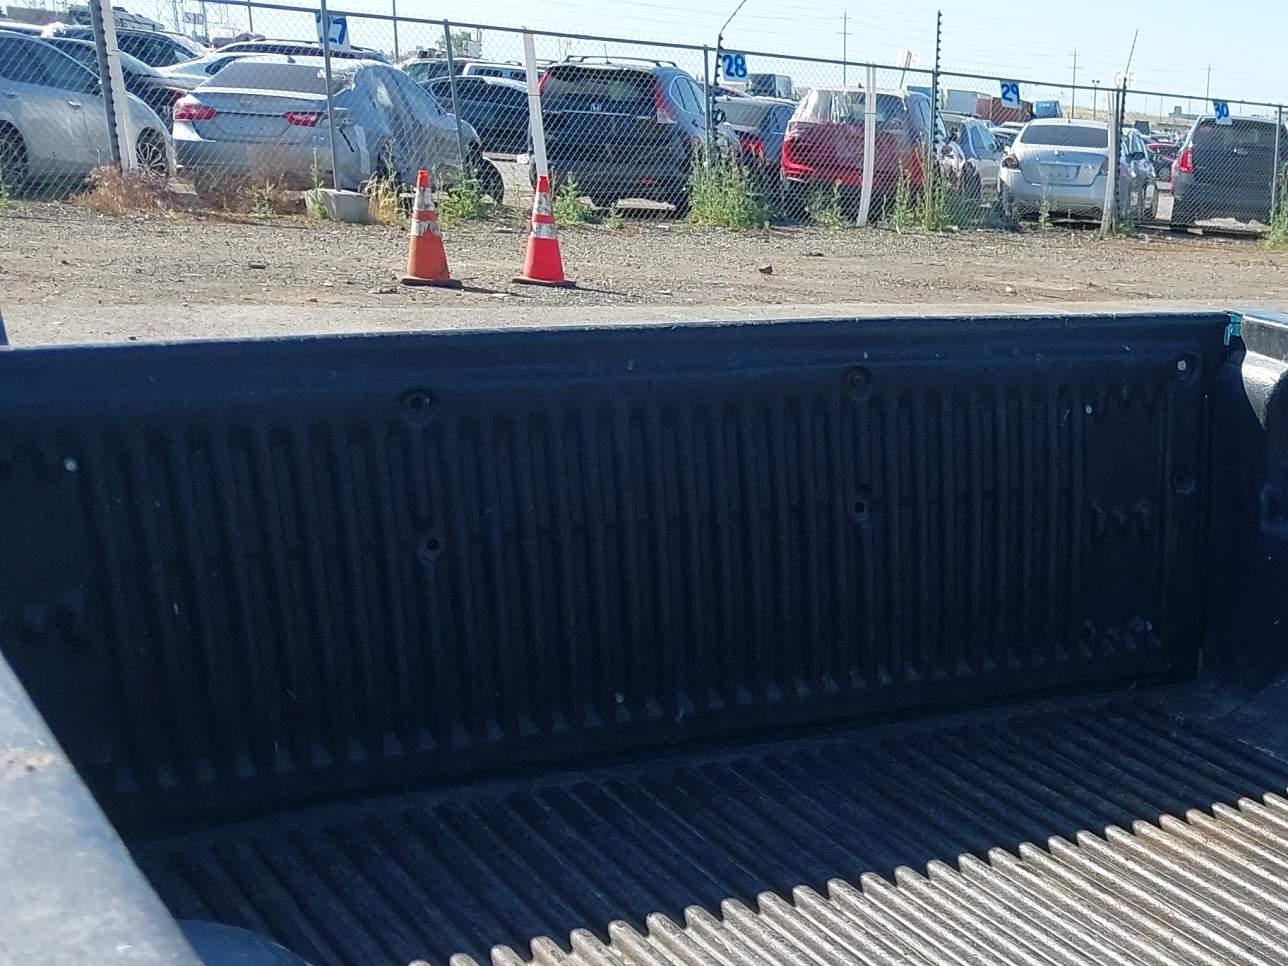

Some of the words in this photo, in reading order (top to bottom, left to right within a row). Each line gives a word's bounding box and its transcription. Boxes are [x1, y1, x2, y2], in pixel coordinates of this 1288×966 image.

[722, 54, 747, 78] 28
[1001, 83, 1020, 105] 29
[1213, 102, 1230, 120] 30
